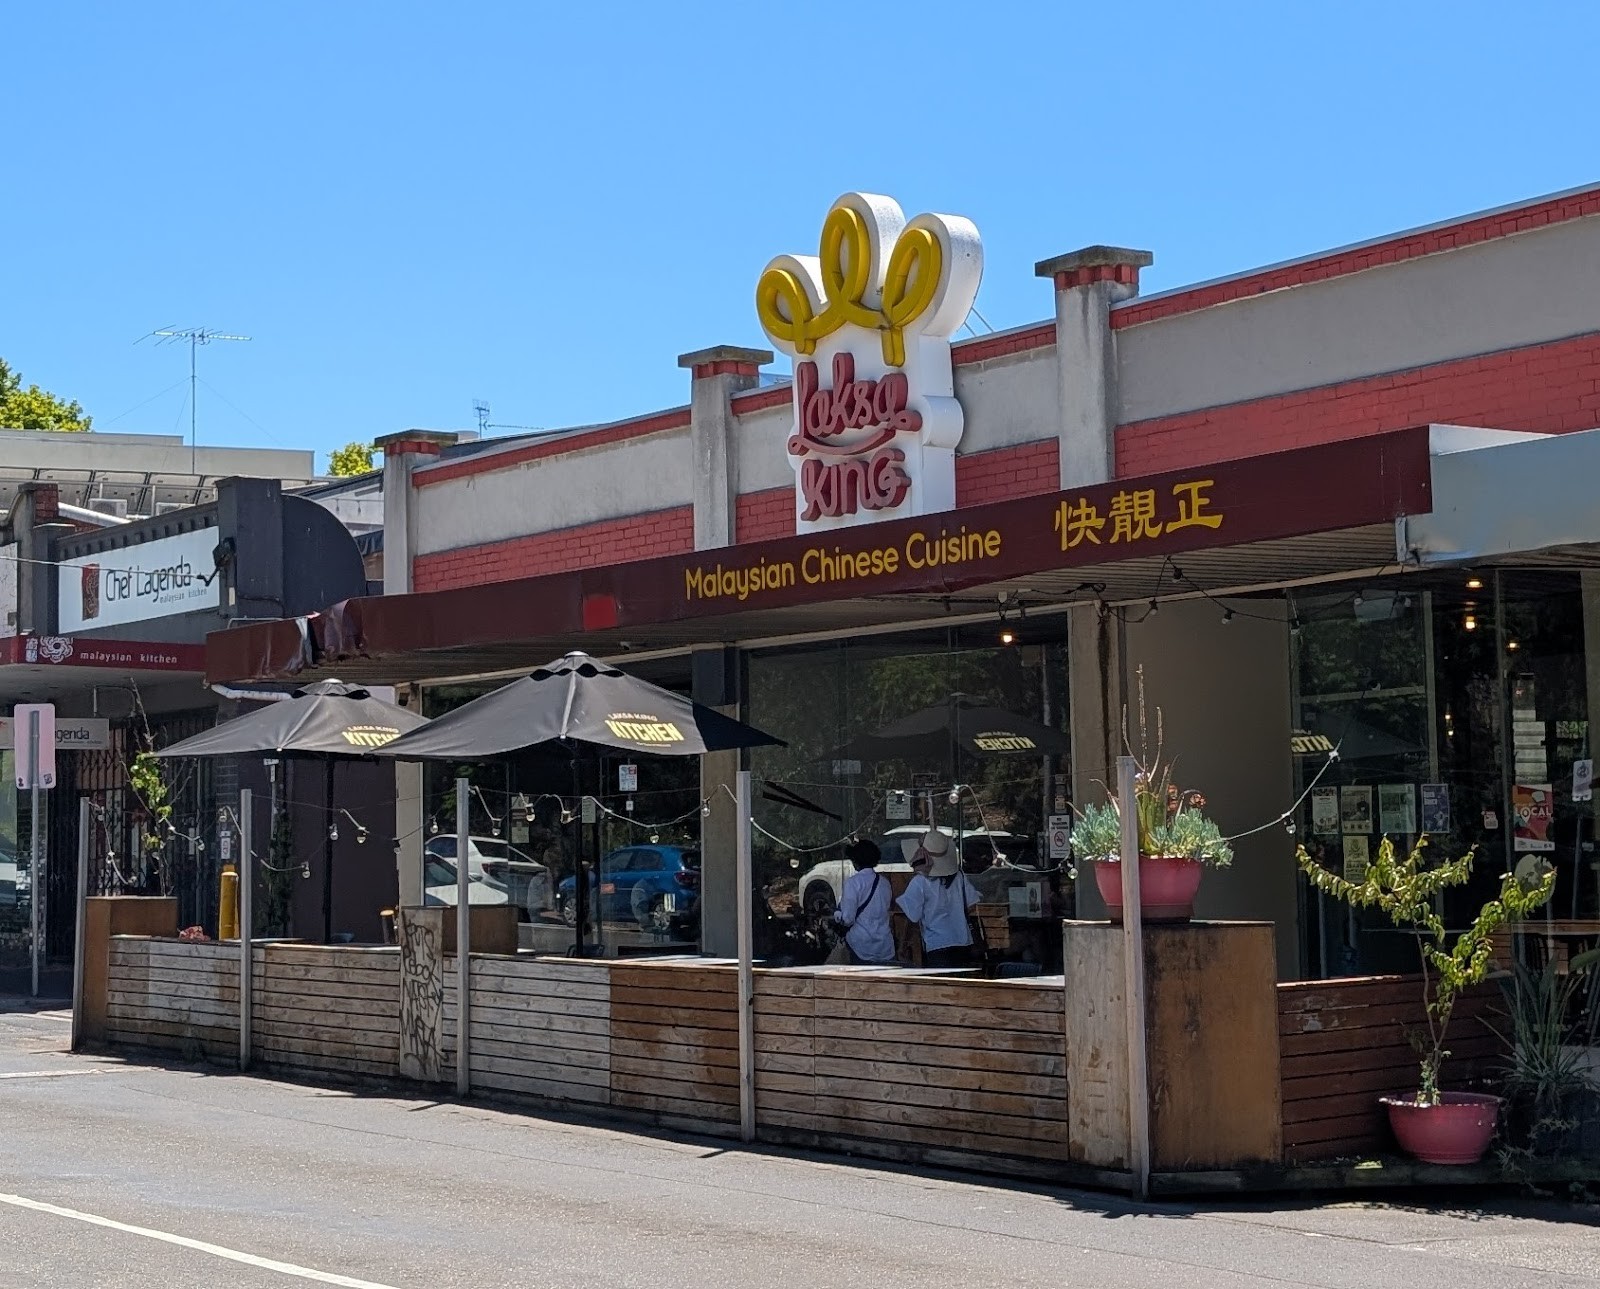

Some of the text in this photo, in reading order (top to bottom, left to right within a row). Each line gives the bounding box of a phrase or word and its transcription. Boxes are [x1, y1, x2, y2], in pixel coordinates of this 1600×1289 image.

[1055, 480, 1223, 551] 快靚正
[106, 554, 191, 603] Chef Lagenda
[685, 525, 1001, 600] Malaysian Chinese Cuisine
[80, 651, 178, 664] malaysian kitchen
[605, 720, 685, 741] KITCHEN
[1515, 806, 1552, 821] LOCAL
